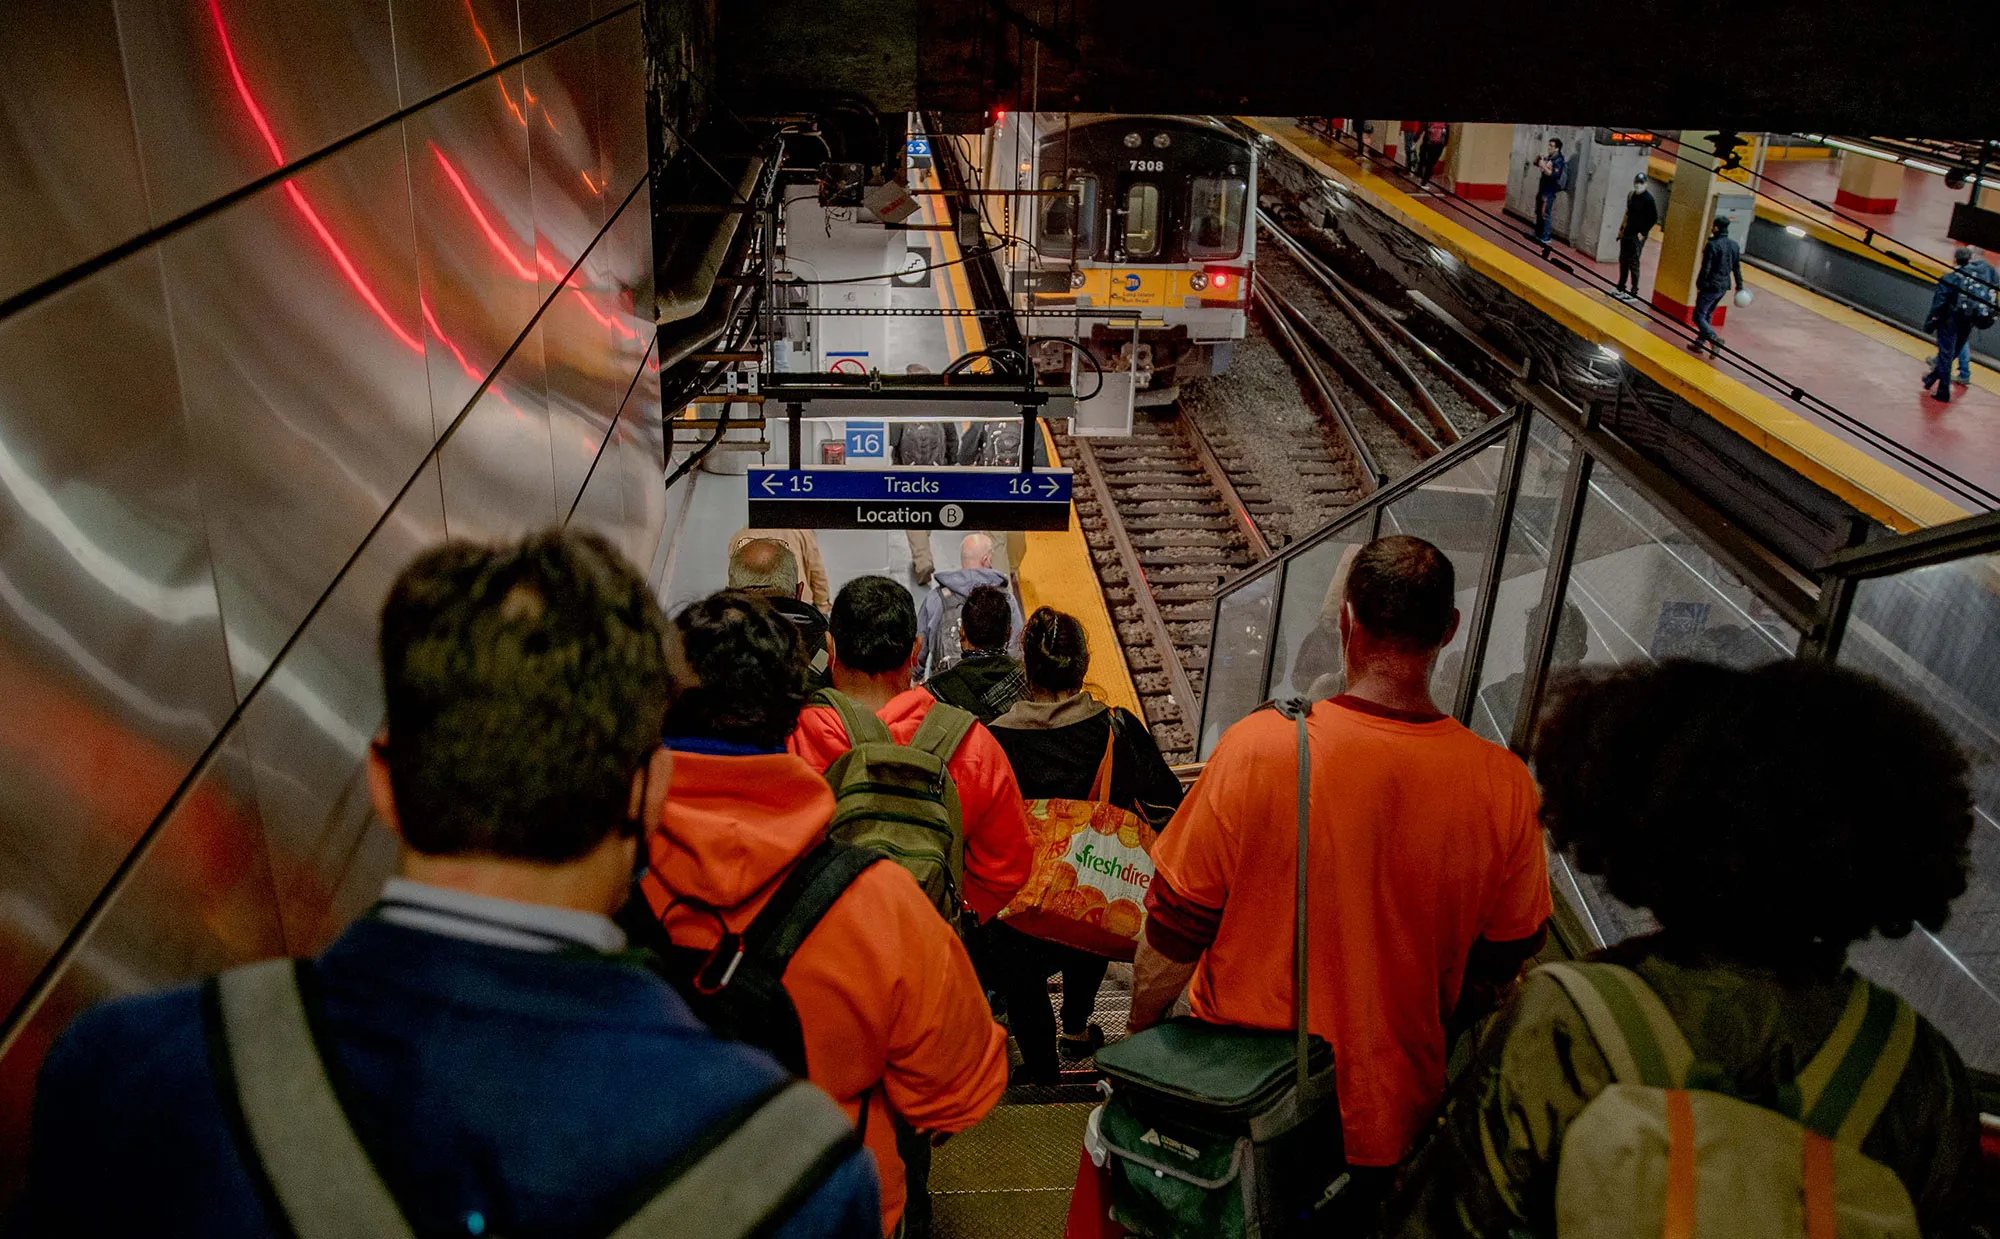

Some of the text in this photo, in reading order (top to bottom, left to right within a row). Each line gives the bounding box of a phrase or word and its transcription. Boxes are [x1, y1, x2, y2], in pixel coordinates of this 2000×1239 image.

[907, 143, 914, 152] 6
[1129, 160, 1164, 171] 7308
[852, 434, 880, 453] 16
[790, 475, 1032, 494] 15 Tracks 16
[857, 506, 932, 523] Location
[1081, 844, 1151, 889] freshdire
